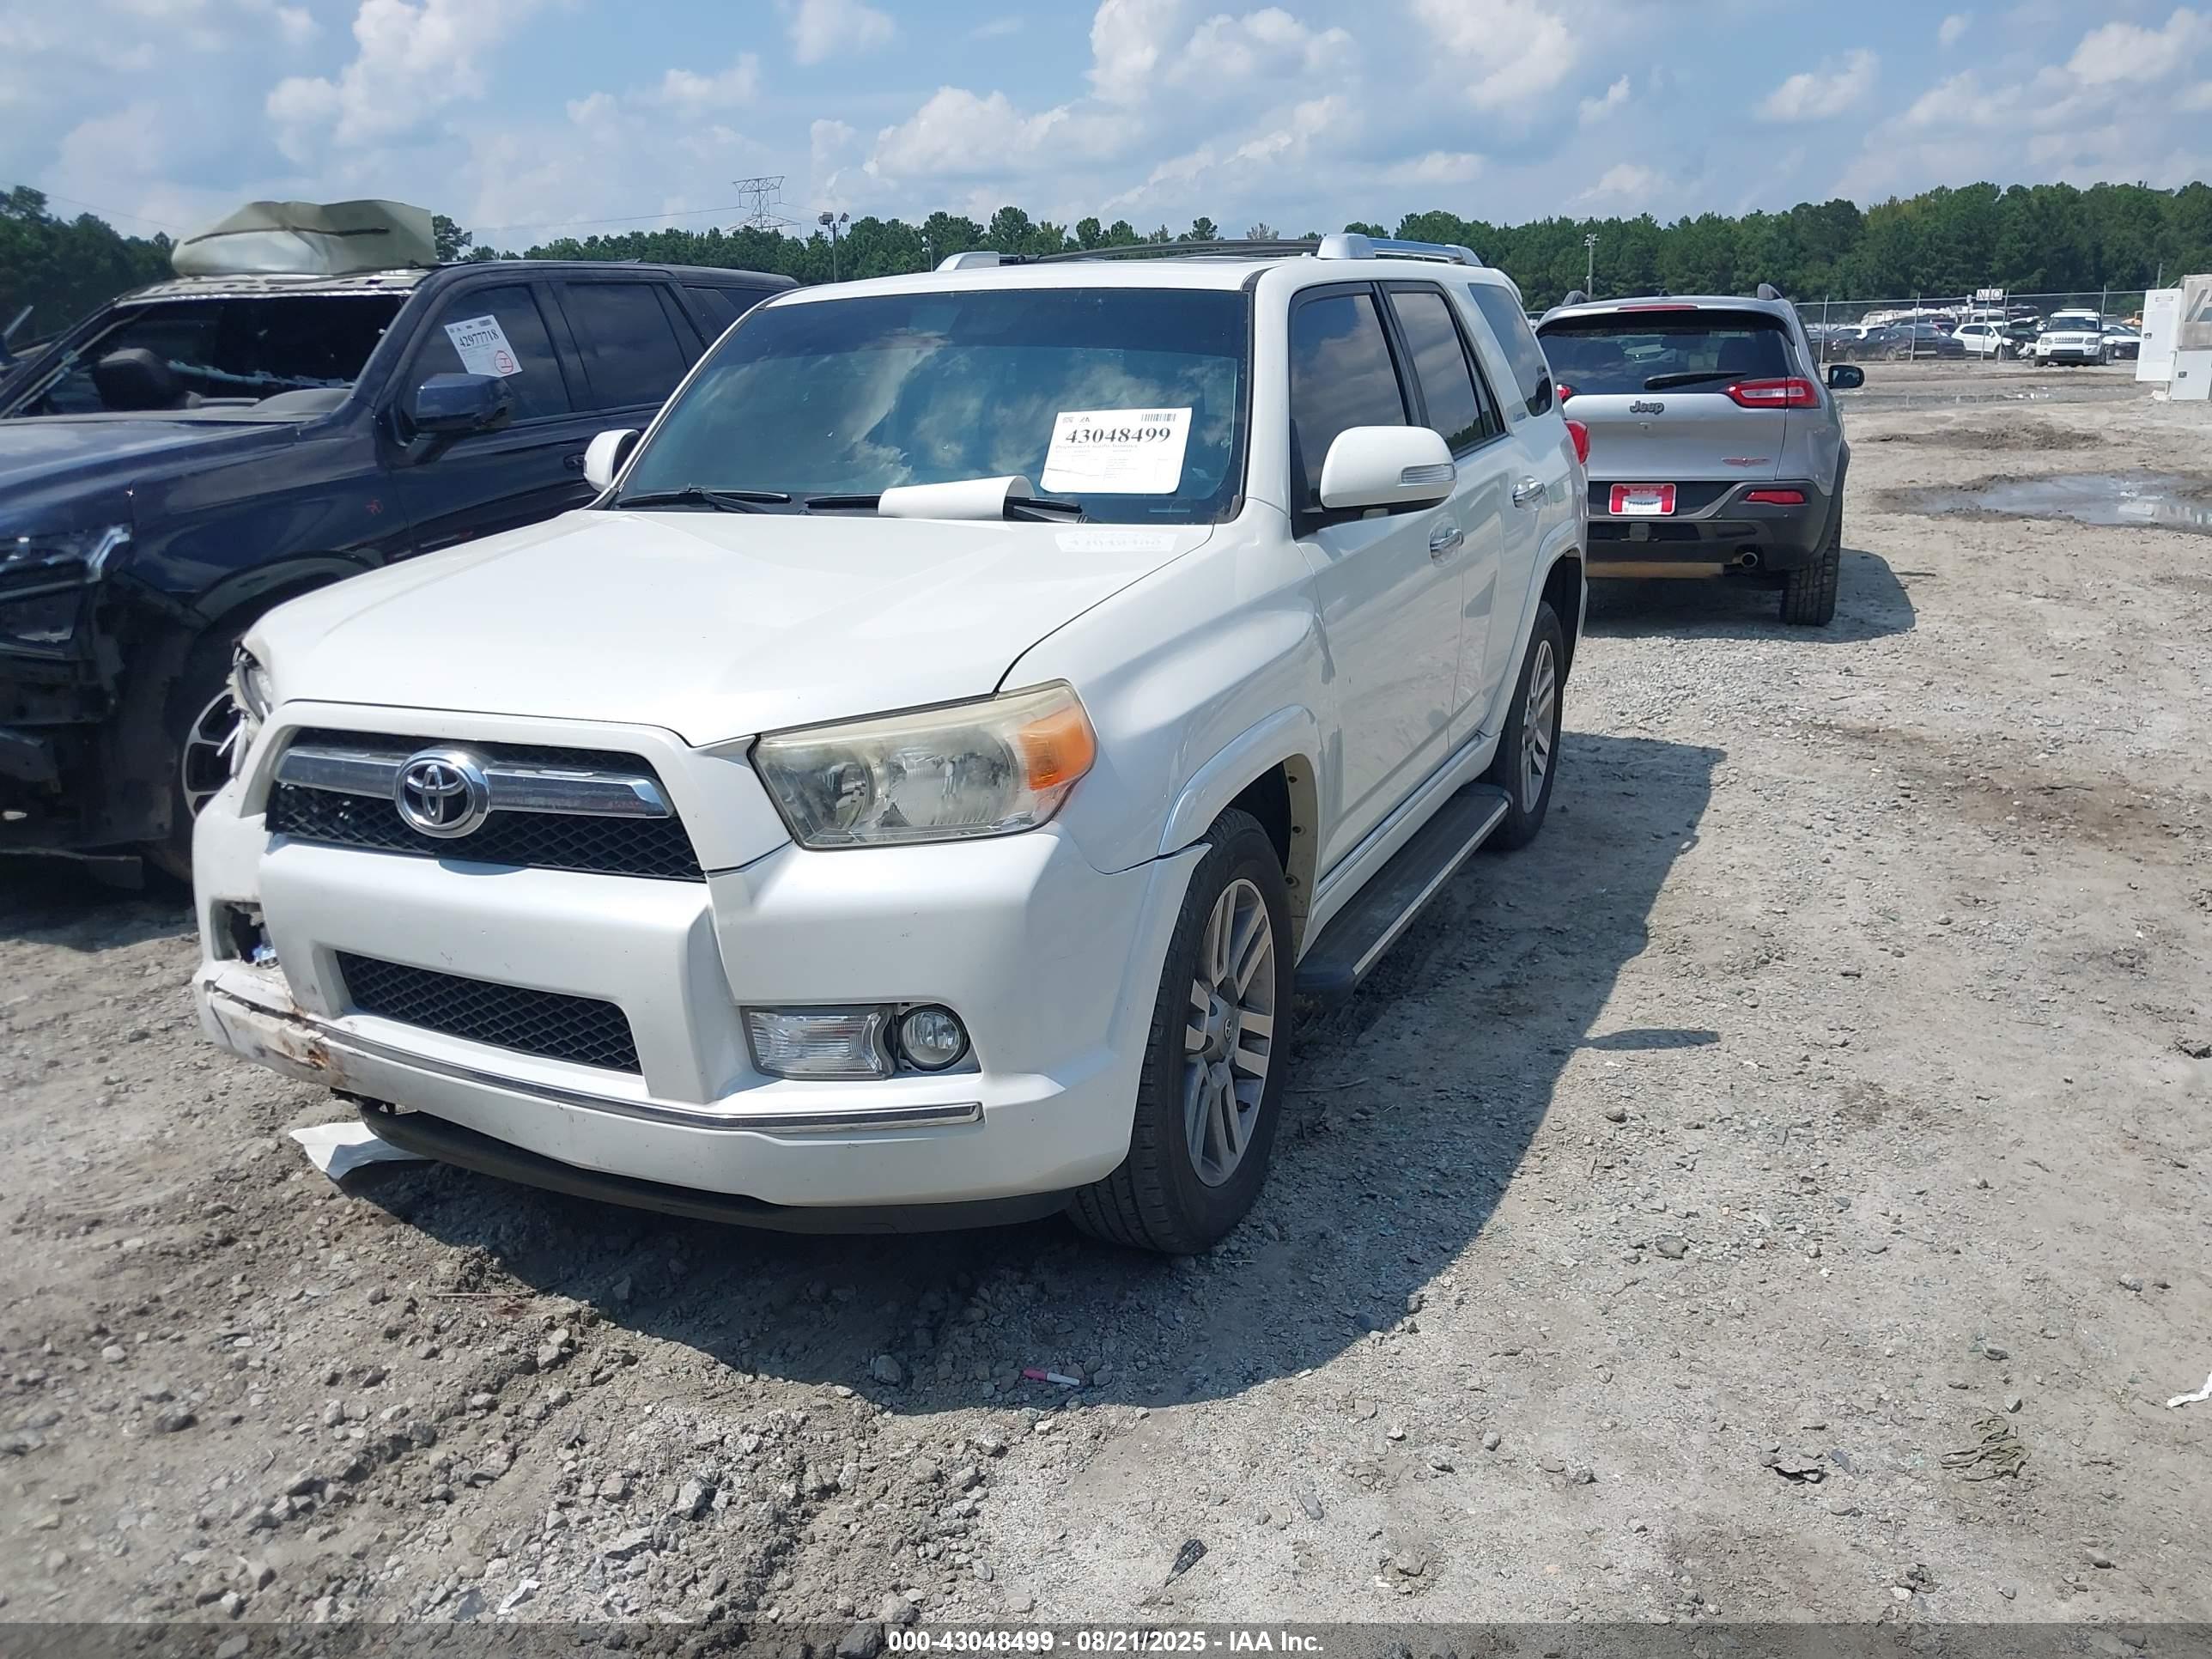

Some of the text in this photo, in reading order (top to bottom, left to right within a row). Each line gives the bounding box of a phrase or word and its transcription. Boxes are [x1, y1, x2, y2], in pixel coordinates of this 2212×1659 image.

[459, 329, 499, 347] 42977718
[1629, 400, 1664, 415] Jeep
[1065, 428, 1170, 443] 43048499
